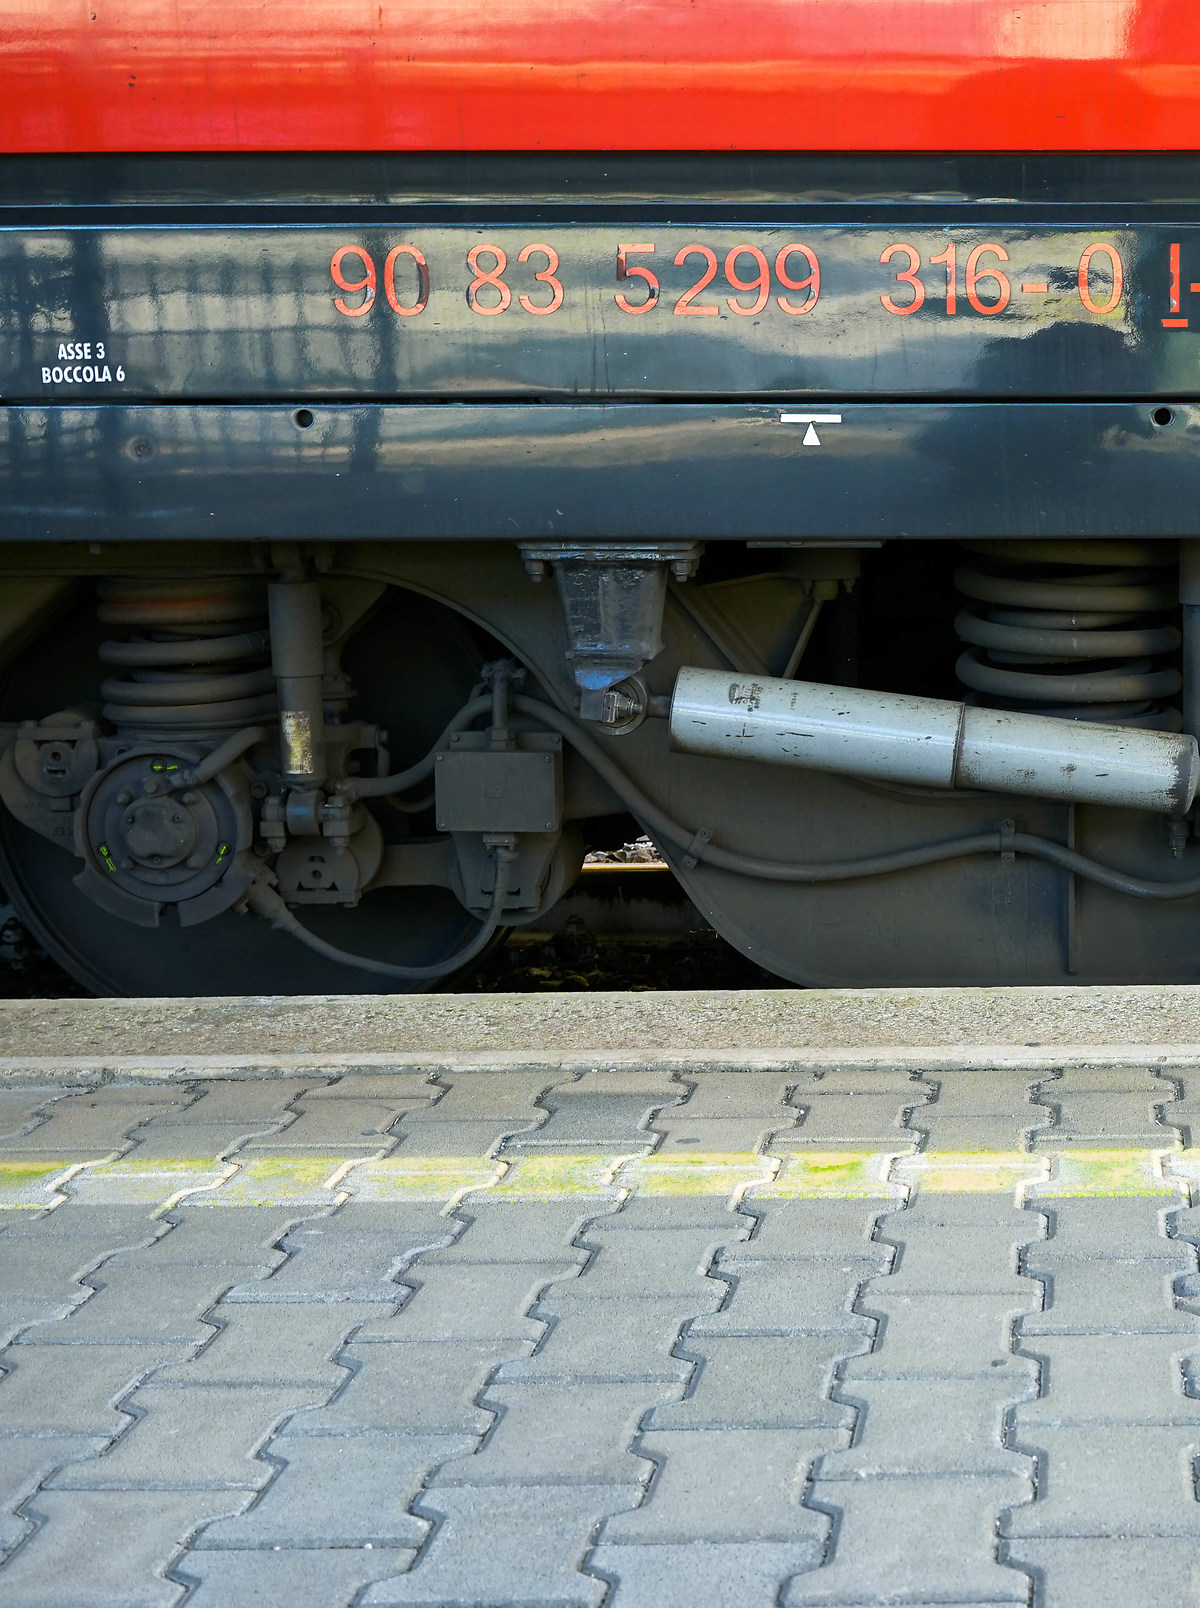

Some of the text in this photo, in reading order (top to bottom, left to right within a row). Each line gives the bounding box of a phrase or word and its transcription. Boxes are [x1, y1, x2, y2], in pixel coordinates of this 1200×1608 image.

[330, 244, 430, 317] 90
[466, 243, 565, 316] 83
[613, 243, 821, 316] 5299
[57, 342, 105, 361] ASSE 3
[41, 365, 126, 384] BOCCOLA 6
